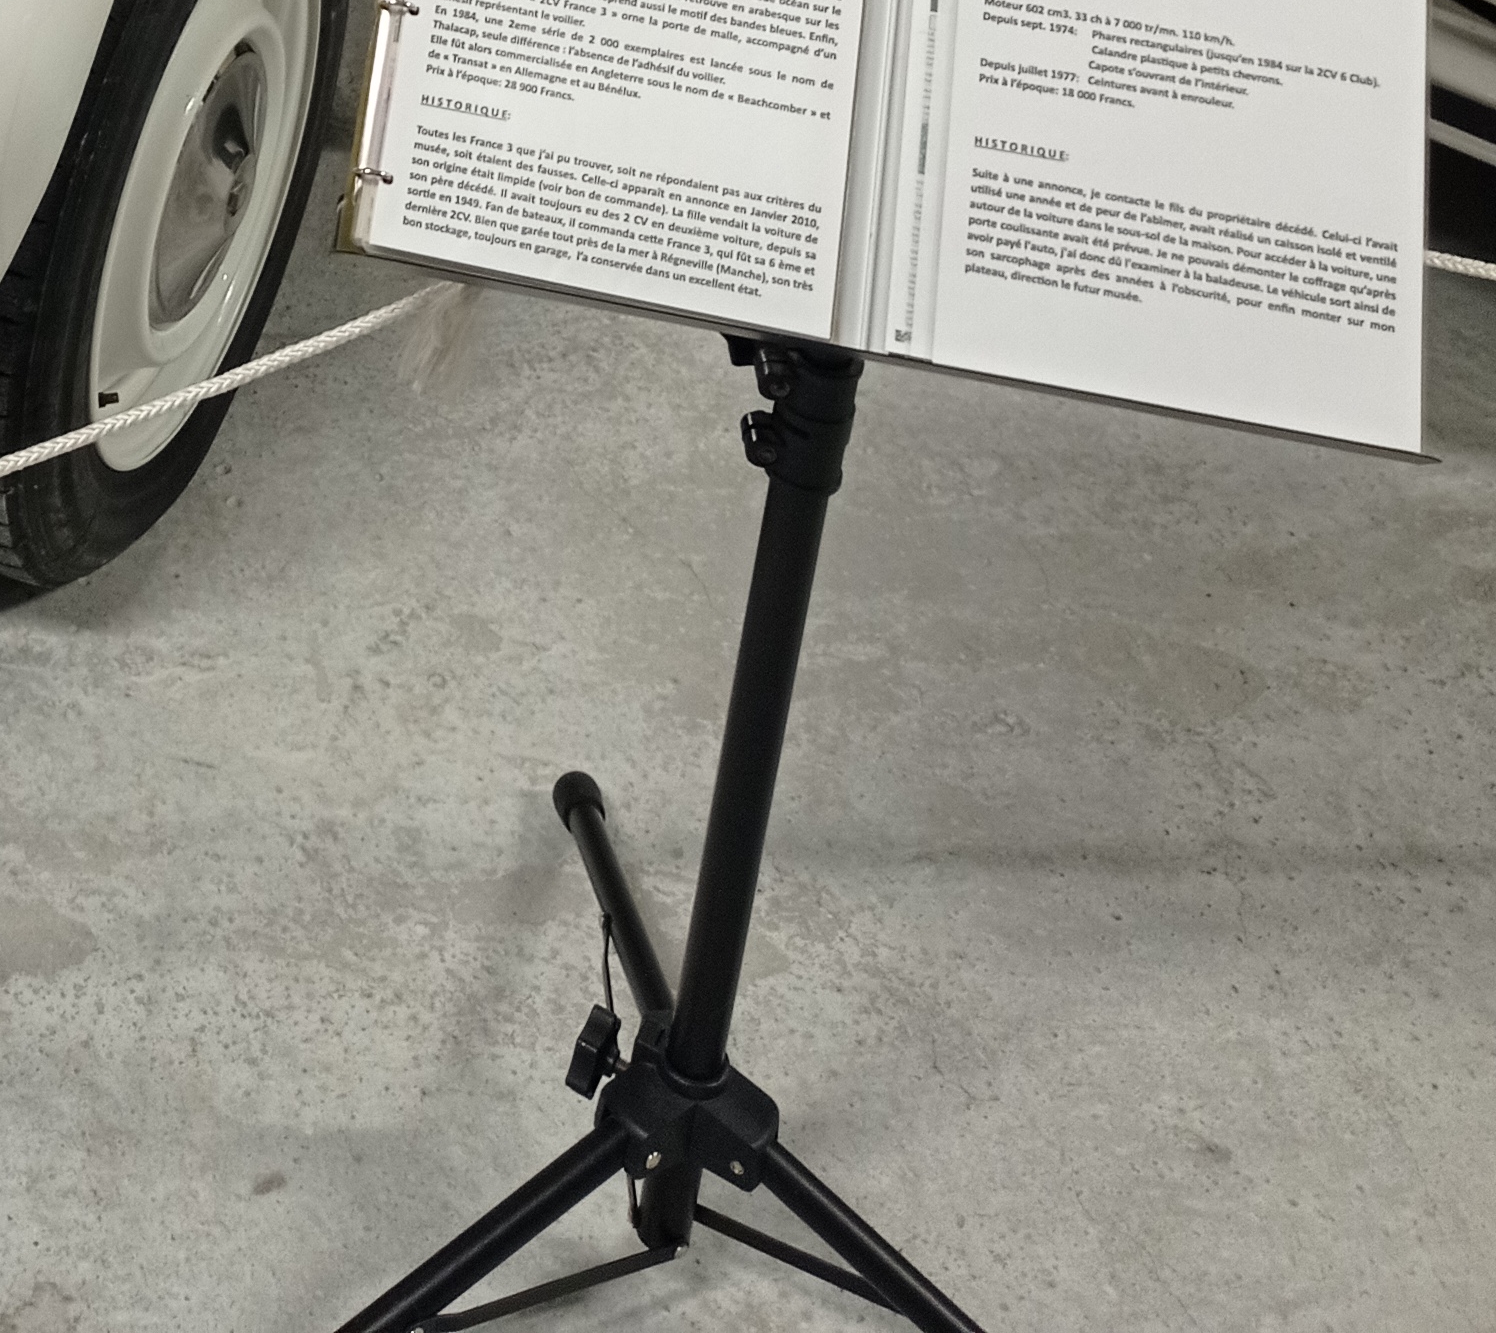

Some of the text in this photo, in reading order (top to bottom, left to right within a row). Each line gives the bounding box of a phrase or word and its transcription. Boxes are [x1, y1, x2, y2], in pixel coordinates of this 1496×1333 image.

[434, 4, 448, 16] En
[452, 8, 479, 23] 1984,
[484, 16, 504, 27] une
[541, 26, 566, 39] série
[570, 31, 584, 42] de
[588, 34, 596, 45] 2
[599, 37, 620, 49] 000
[623, 43, 685, 62] exemplaires
[689, 56, 706, 66] est
[710, 57, 744, 73] lancée
[748, 67, 772, 79] sous
[776, 70, 787, 81] le
[791, 75, 816, 87] nom
[820, 79, 835, 91] de
[474, 0, 539, 19] représentant
[540, 9, 551, 21] le
[552, 14, 585, 27] voilier.
[1025, 3, 1045, 15] 602
[1046, 8, 1072, 20] cm3.
[1075, 11, 1088, 22] 33
[1089, 14, 1103, 25] ch
[1104, 16, 1112, 26] à
[1113, 17, 1121, 28] 7
[1122, 19, 1143, 31] 000
[1144, 23, 1179, 37] tr/mn.
[1182, 29, 1202, 41] 110
[1203, 32, 1235, 47] km/h.
[979, 57, 1235, 109] Depuis juillet 1977: Ceintures avant à enrouleur.
[1091, 45, 1283, 86] Calandre plastique à petits chevrons.
[413, 141, 820, 231] musée, soit étaient des fausses. Celle-ci apparaît en annonce en Janvier 2010,
[404, 200, 814, 292] dernière 2CV. Bien que garée tout près de la mer à Régneville (Manche), son très
[969, 200, 1397, 285] autour de la voiture dans le sous-sol de la maison. Pour accéder à la voiture, une
